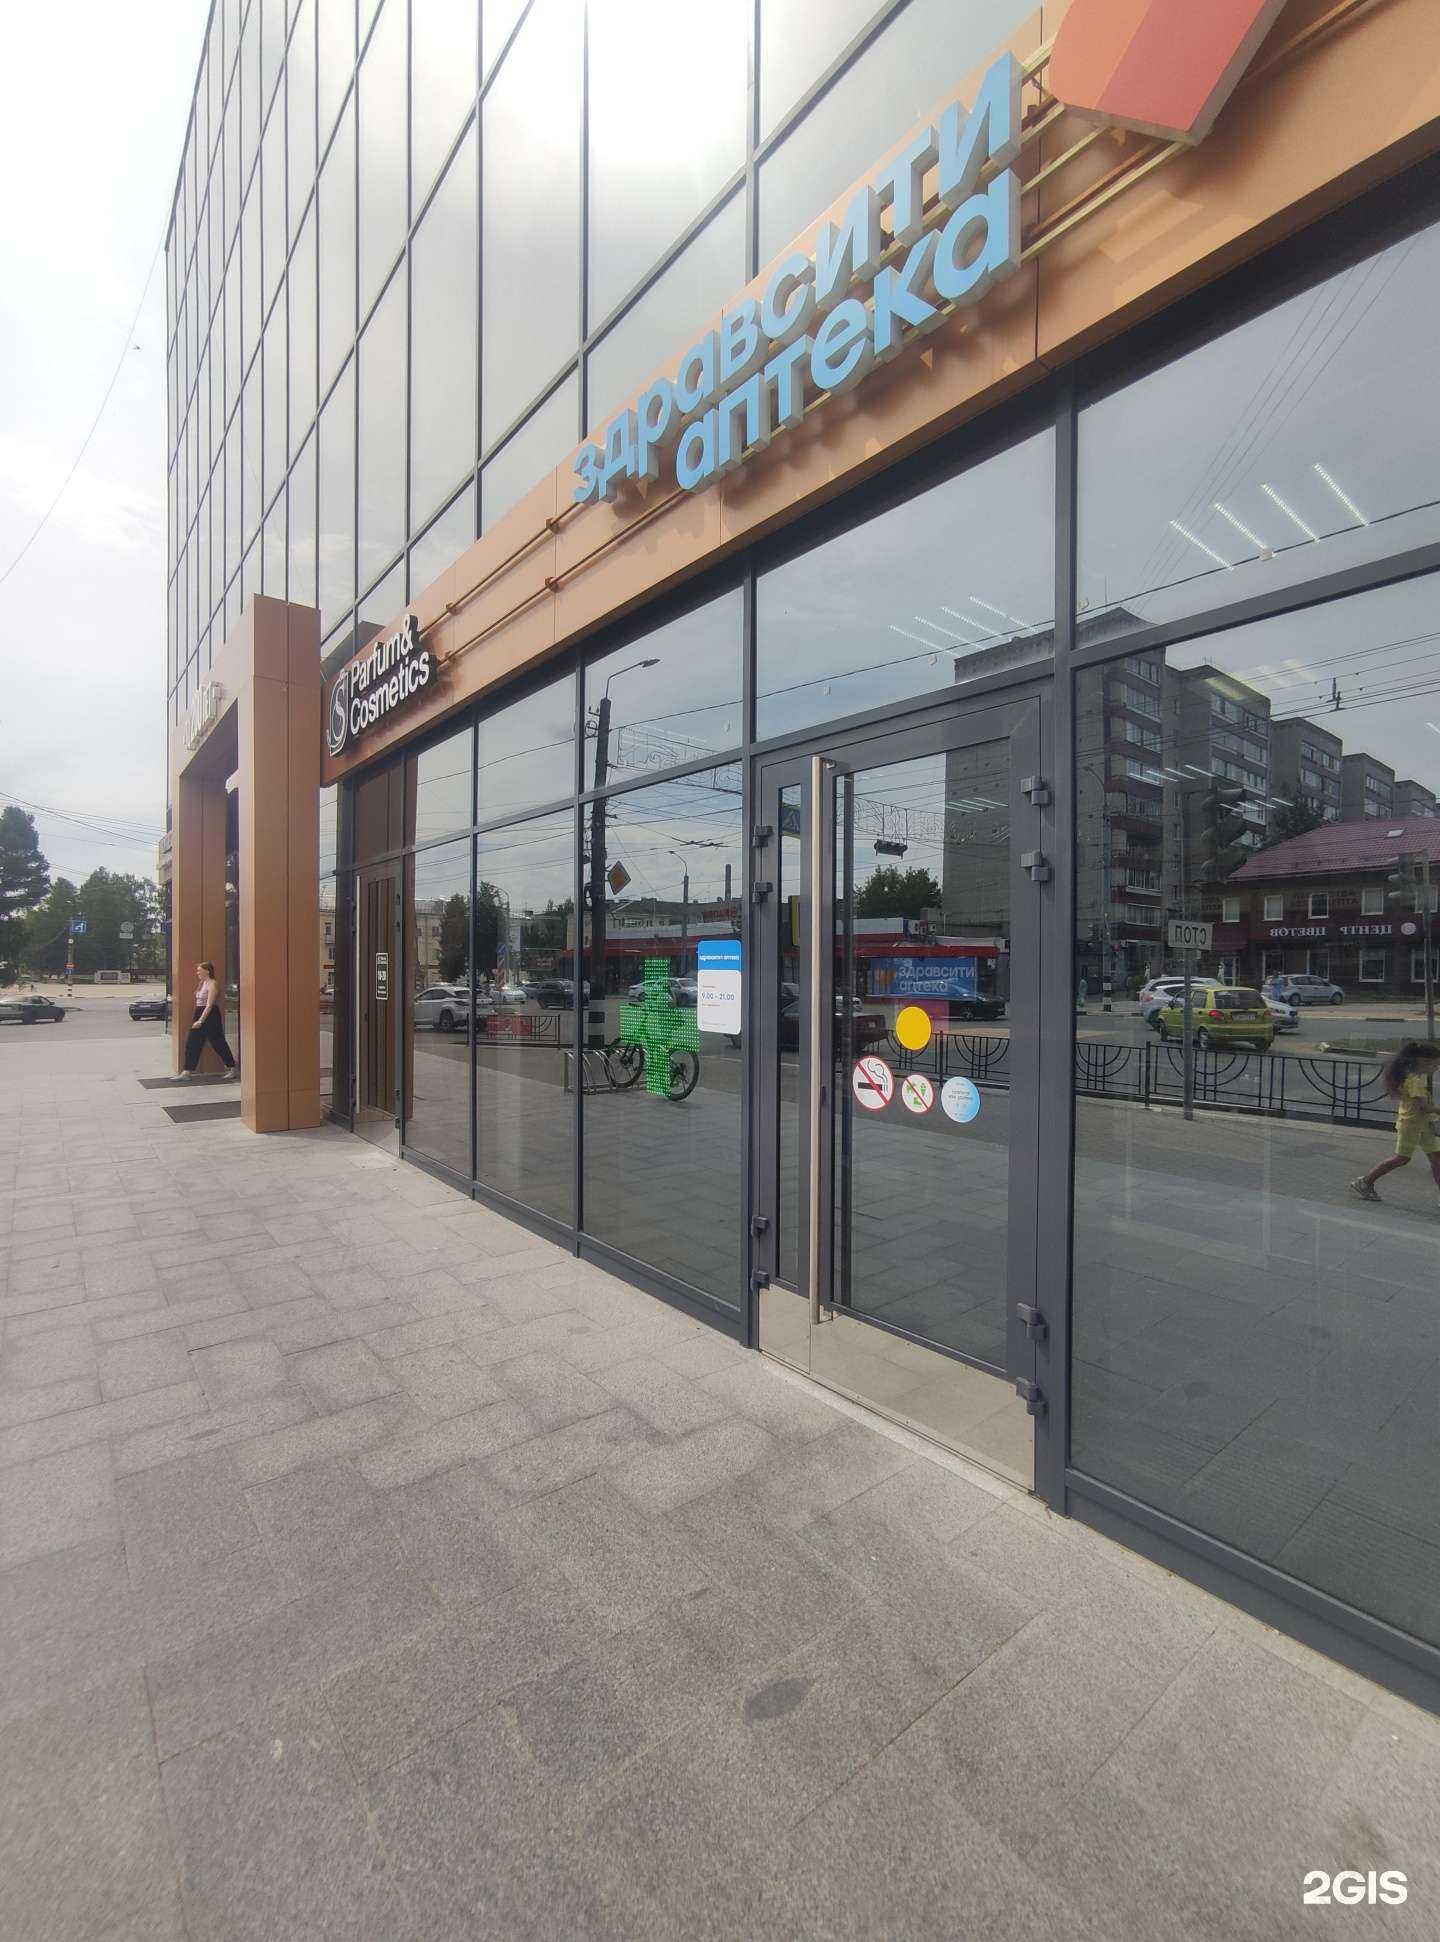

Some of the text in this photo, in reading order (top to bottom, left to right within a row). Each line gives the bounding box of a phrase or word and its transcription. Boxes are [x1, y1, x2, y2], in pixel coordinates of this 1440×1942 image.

[573, 50, 1020, 502] здравсити
[677, 168, 1020, 490] аптека
[350, 651, 429, 735] Cosmetics
[899, 966, 976, 980] здравсити
